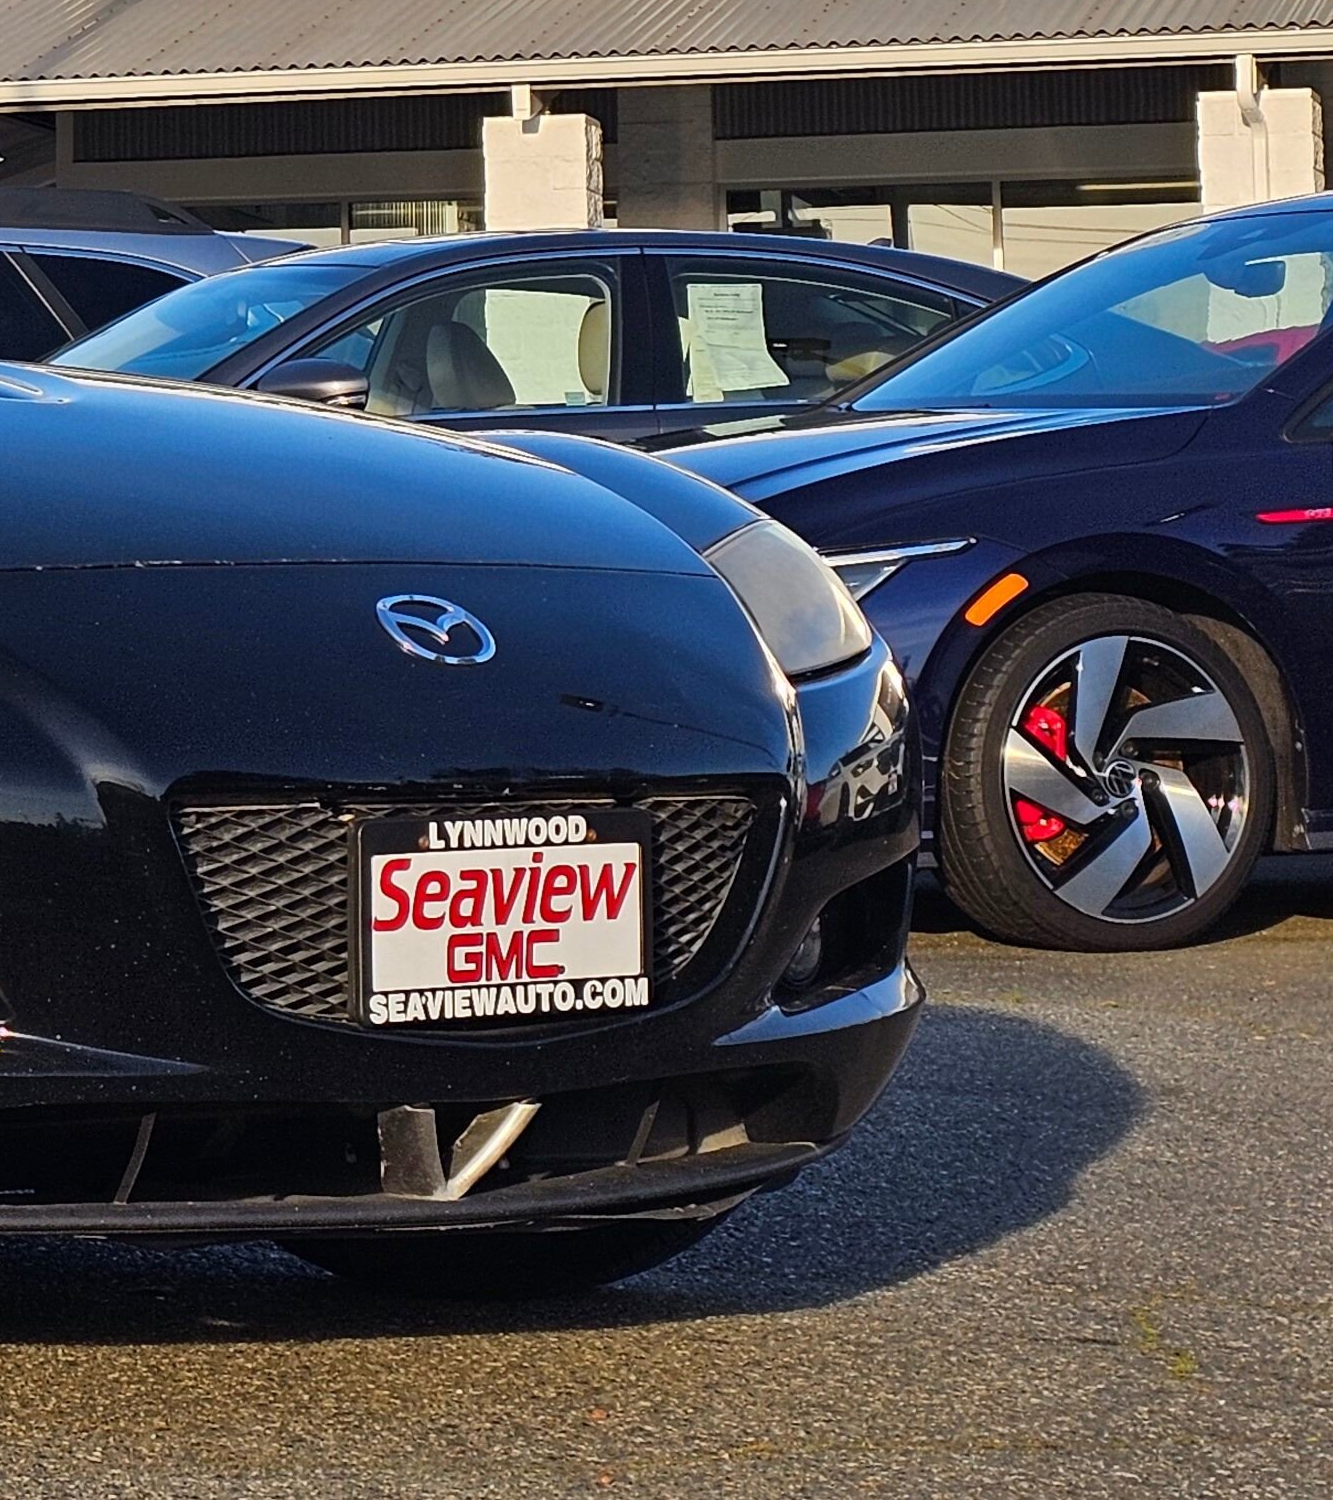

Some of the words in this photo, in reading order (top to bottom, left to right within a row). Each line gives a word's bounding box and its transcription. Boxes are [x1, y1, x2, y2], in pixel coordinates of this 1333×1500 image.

[428, 815, 587, 850] LYNNWOOD
[372, 851, 637, 932] Seaview
[446, 929, 561, 984] GMC
[369, 977, 649, 1025] SEAVIEWAUTO.COM
